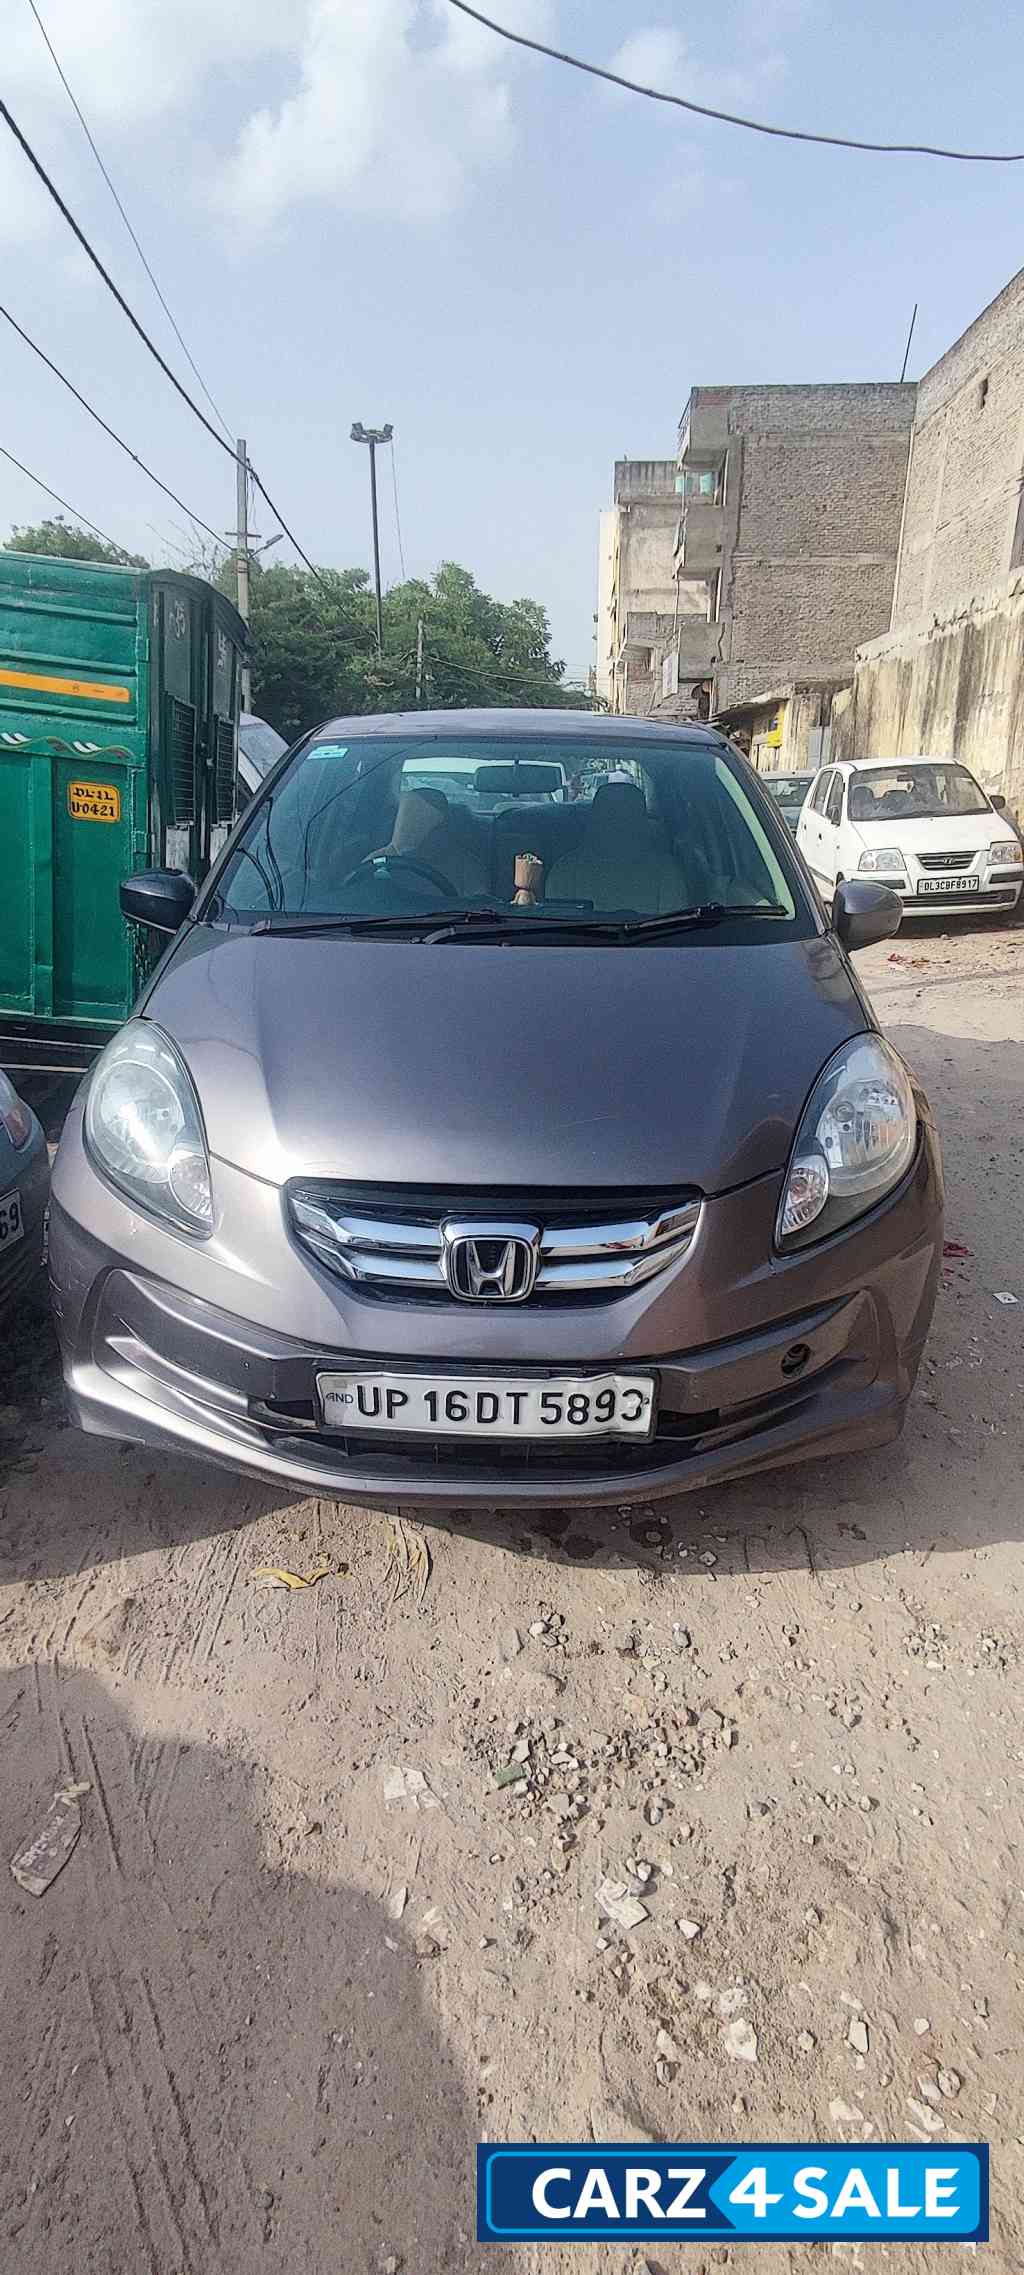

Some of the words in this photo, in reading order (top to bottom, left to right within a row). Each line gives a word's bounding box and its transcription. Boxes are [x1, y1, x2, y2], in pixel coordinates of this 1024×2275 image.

[356, 1385, 408, 1419] UP
[424, 1390, 528, 1425] 16DT
[540, 1388, 643, 1425] 5893
